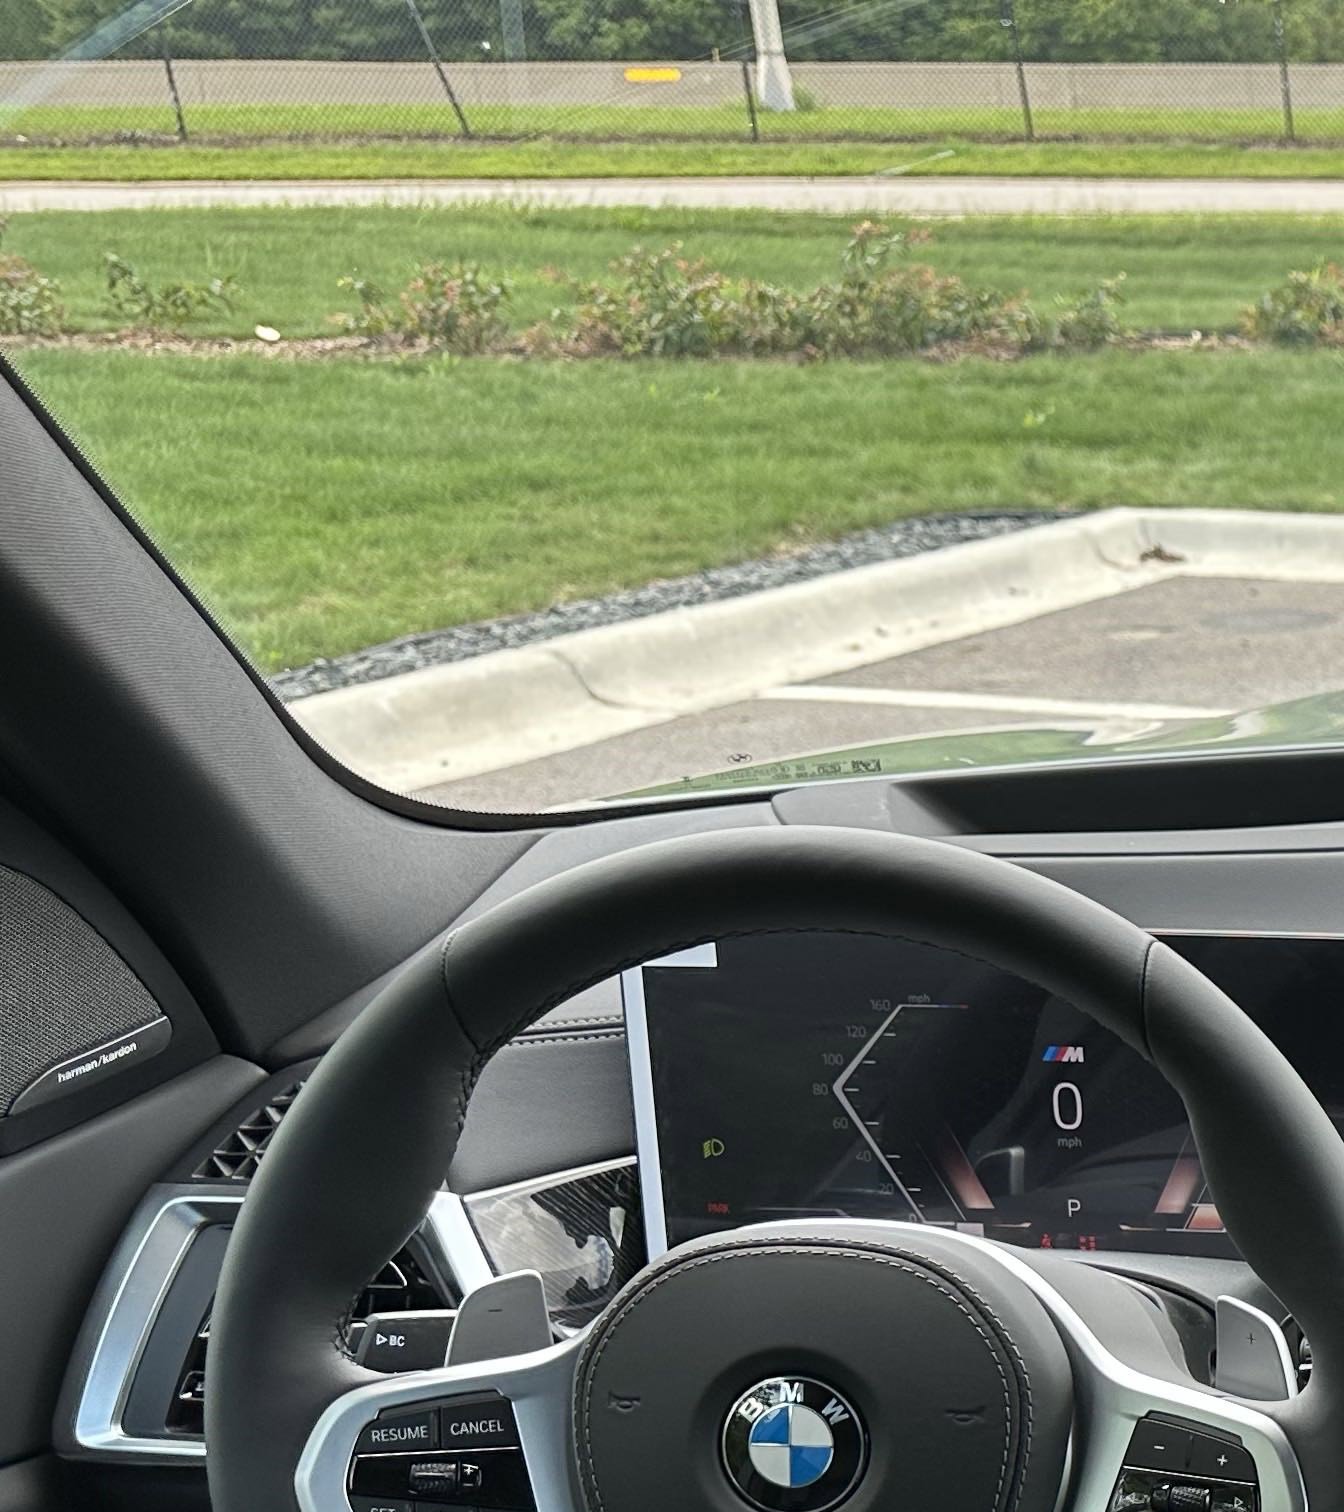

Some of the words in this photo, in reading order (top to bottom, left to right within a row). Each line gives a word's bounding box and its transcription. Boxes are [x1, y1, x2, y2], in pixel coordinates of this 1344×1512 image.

[870, 999, 890, 1011] 160
[846, 1026, 867, 1037] 120
[57, 1041, 137, 1083] harman/kardon
[823, 1054, 844, 1065] 100
[813, 1084, 828, 1095] 80
[1053, 1082, 1082, 1130] 0
[833, 1118, 848, 1129] 60
[1057, 1137, 1081, 1149] mph
[857, 1151, 872, 1162] 40
[880, 1184, 894, 1195] 20
[1068, 1200, 1081, 1217] P
[738, 1379, 850, 1426] BMW
[371, 1424, 429, 1443] RESUME
[450, 1419, 505, 1437] CANCEL
